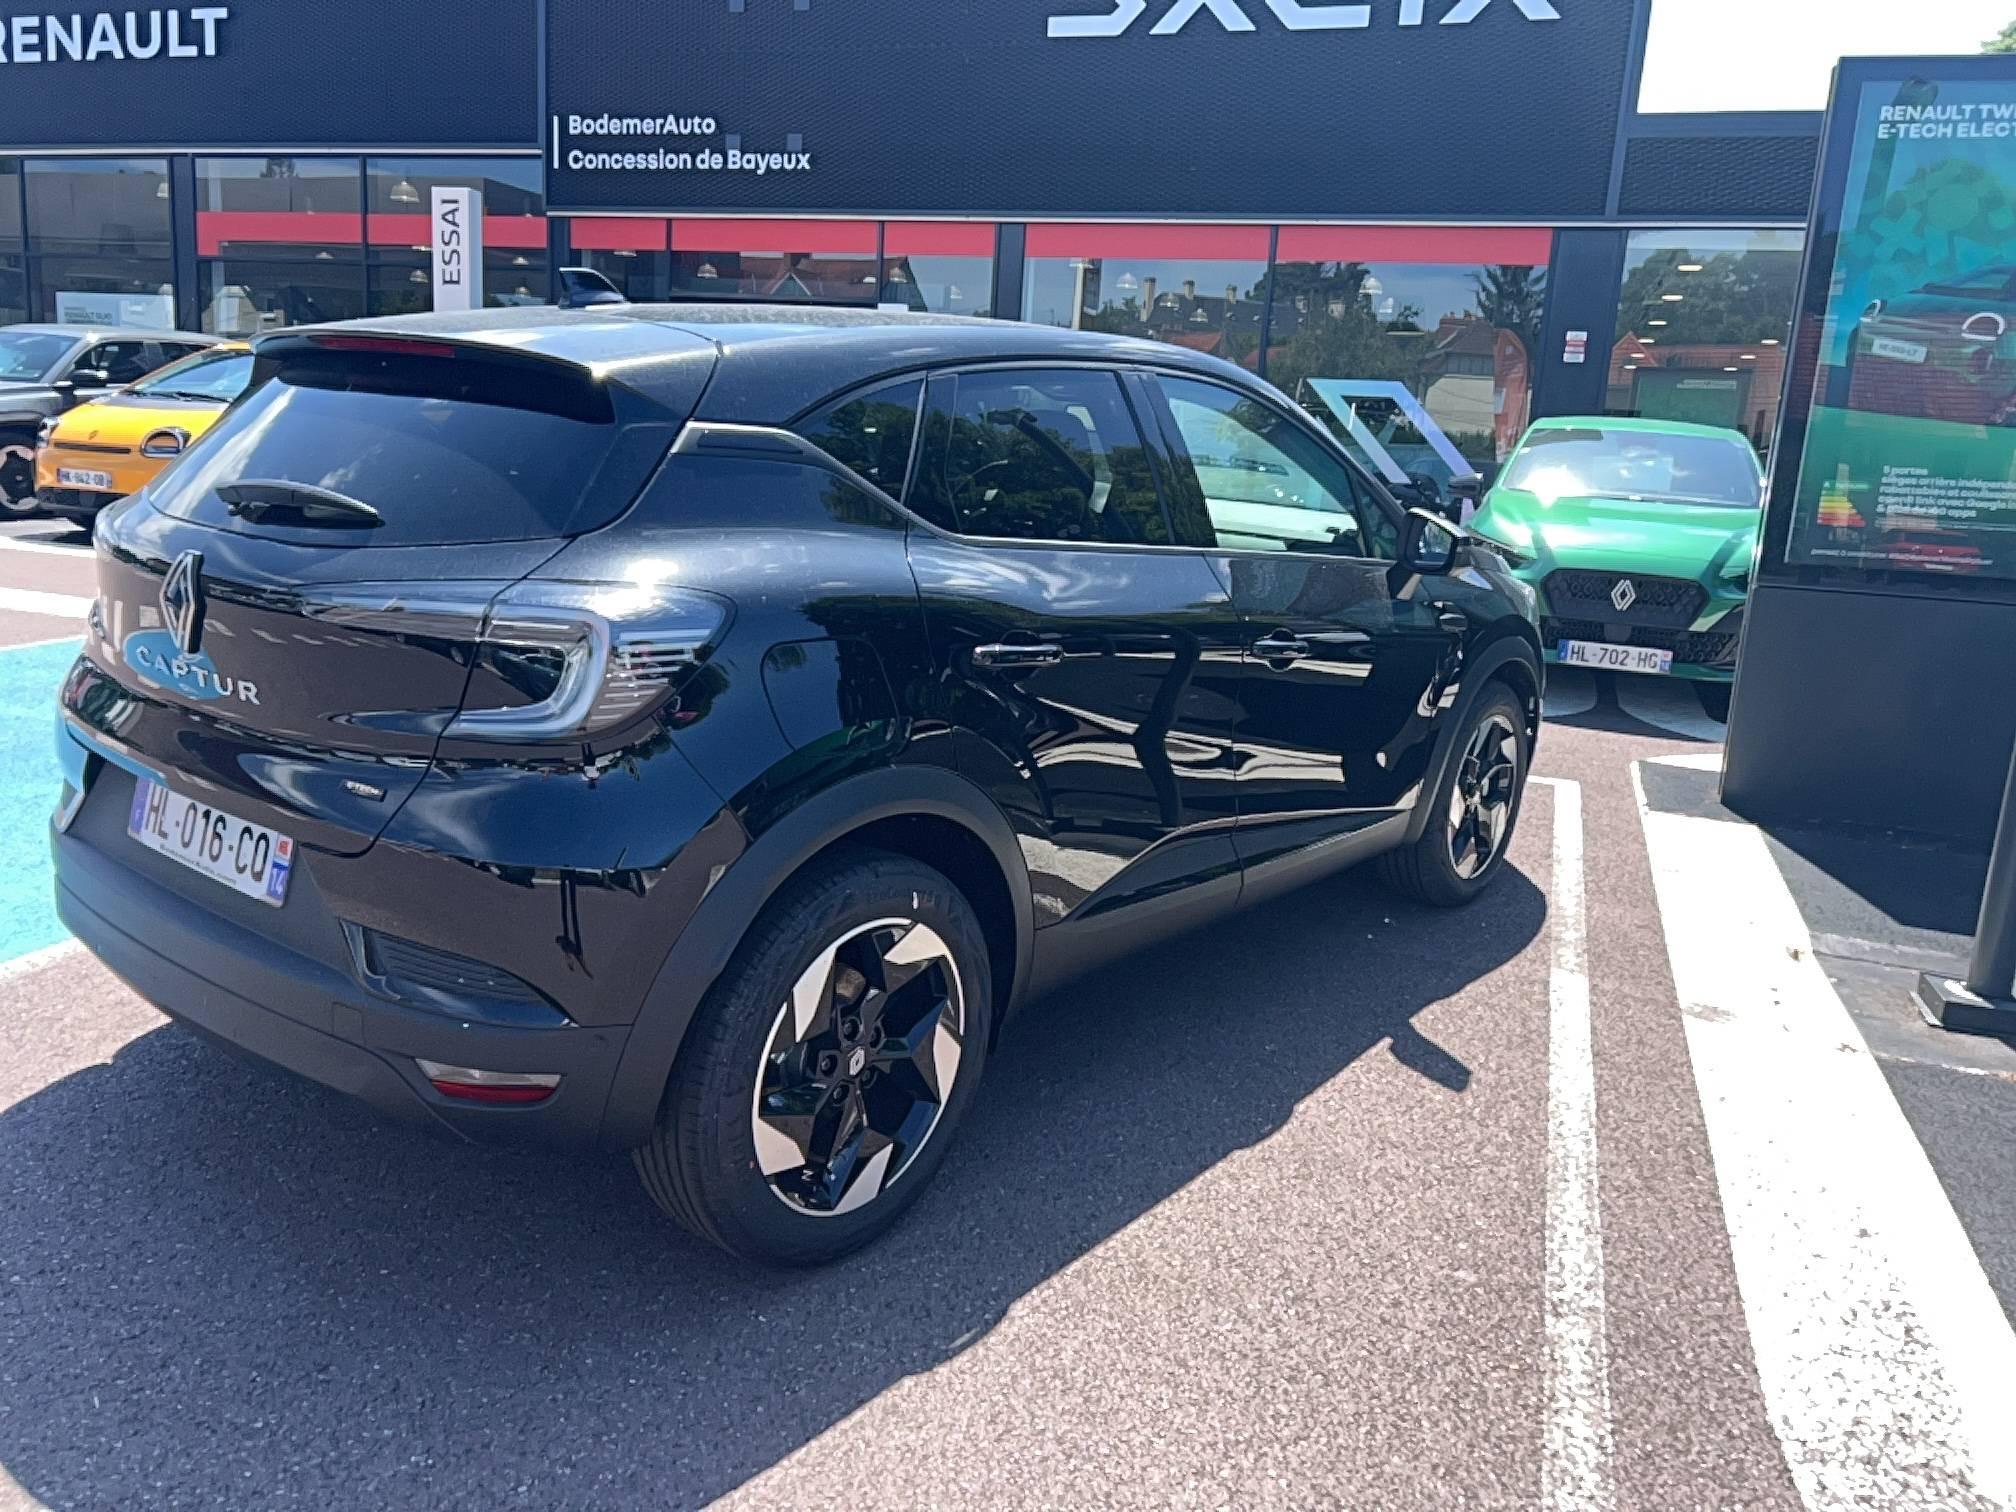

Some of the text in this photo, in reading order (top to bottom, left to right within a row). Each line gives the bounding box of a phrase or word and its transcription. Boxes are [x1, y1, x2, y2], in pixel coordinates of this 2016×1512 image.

[0, 8, 229, 63] ENAULT
[568, 113, 717, 136] BodemerAuto
[1880, 104, 1976, 121] RENAULT
[1877, 122, 1953, 139] E-TECH
[567, 148, 811, 176] Concession de Bayeux
[440, 198, 461, 286] ESSAI
[1570, 644, 1659, 670] HL-702-HG
[136, 645, 260, 706] CAPTUR
